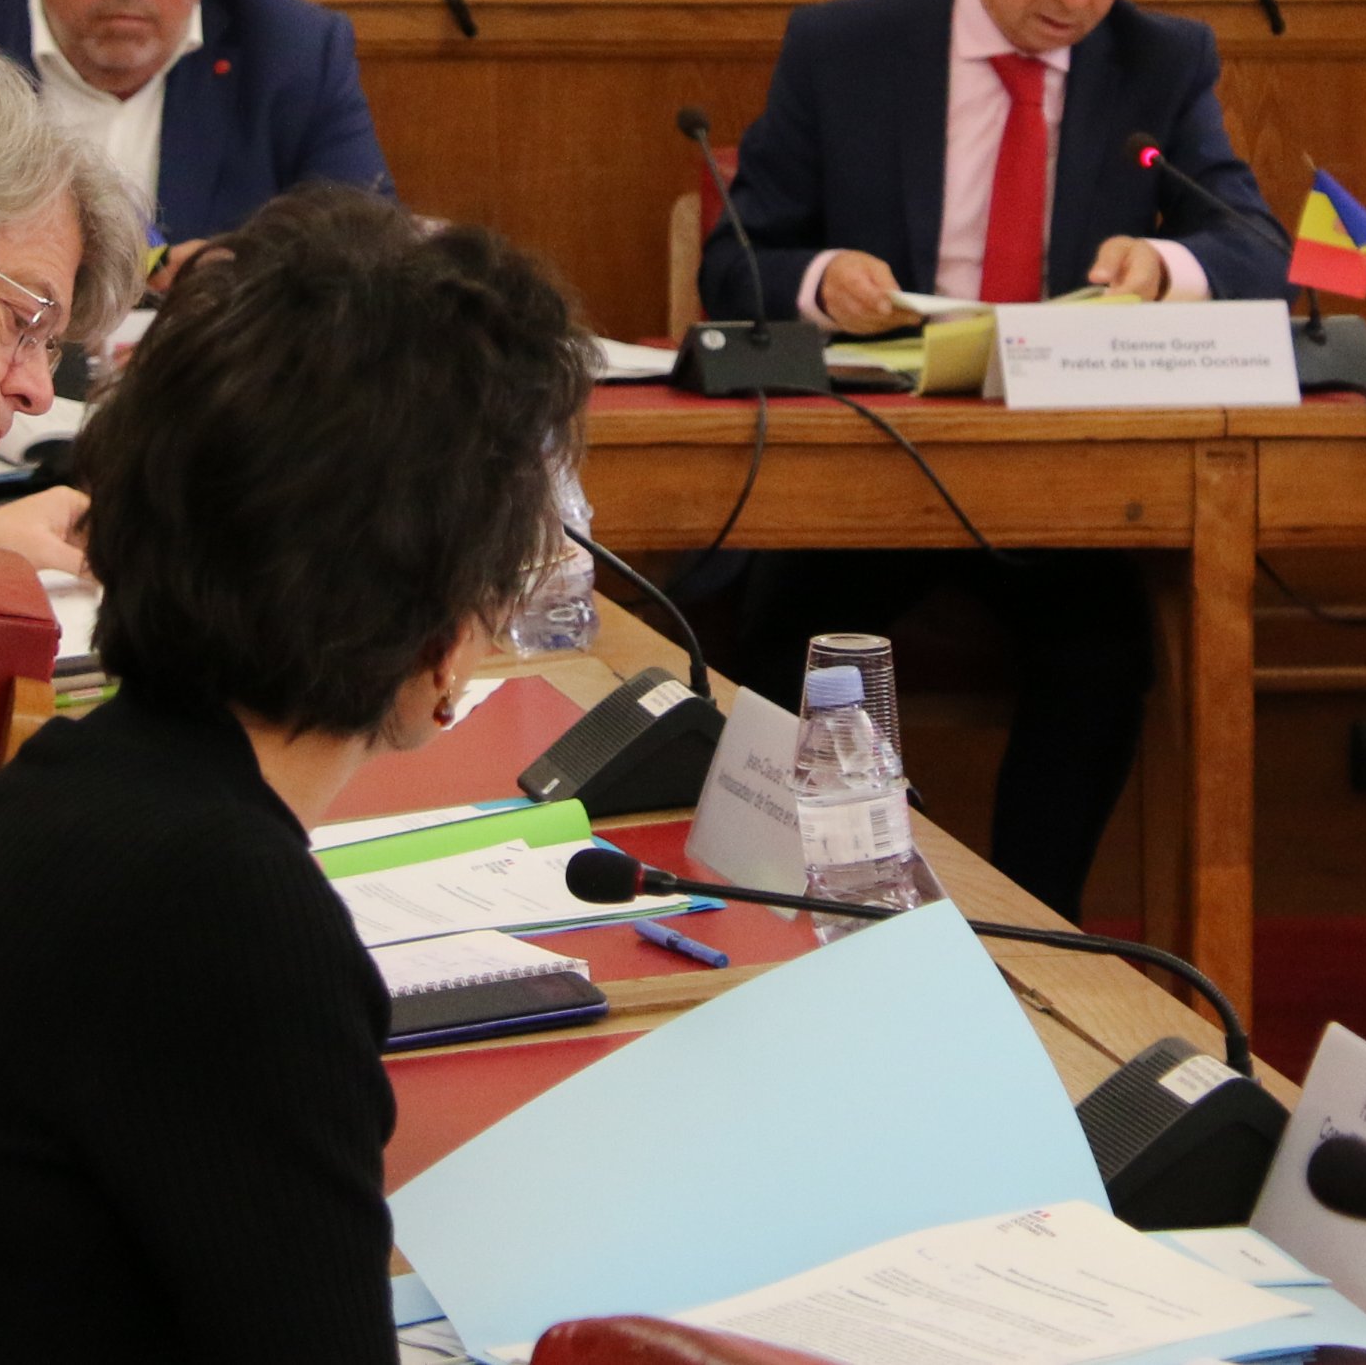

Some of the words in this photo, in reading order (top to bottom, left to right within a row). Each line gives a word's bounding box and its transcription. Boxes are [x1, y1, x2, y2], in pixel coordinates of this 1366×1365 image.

[1171, 337, 1217, 353] Guyot
[1061, 356, 1106, 370] Préfet
[1109, 355, 1129, 369] de
[1134, 356, 1147, 369] la
[1150, 355, 1197, 372] région
[1201, 354, 1272, 369] Occitanie
